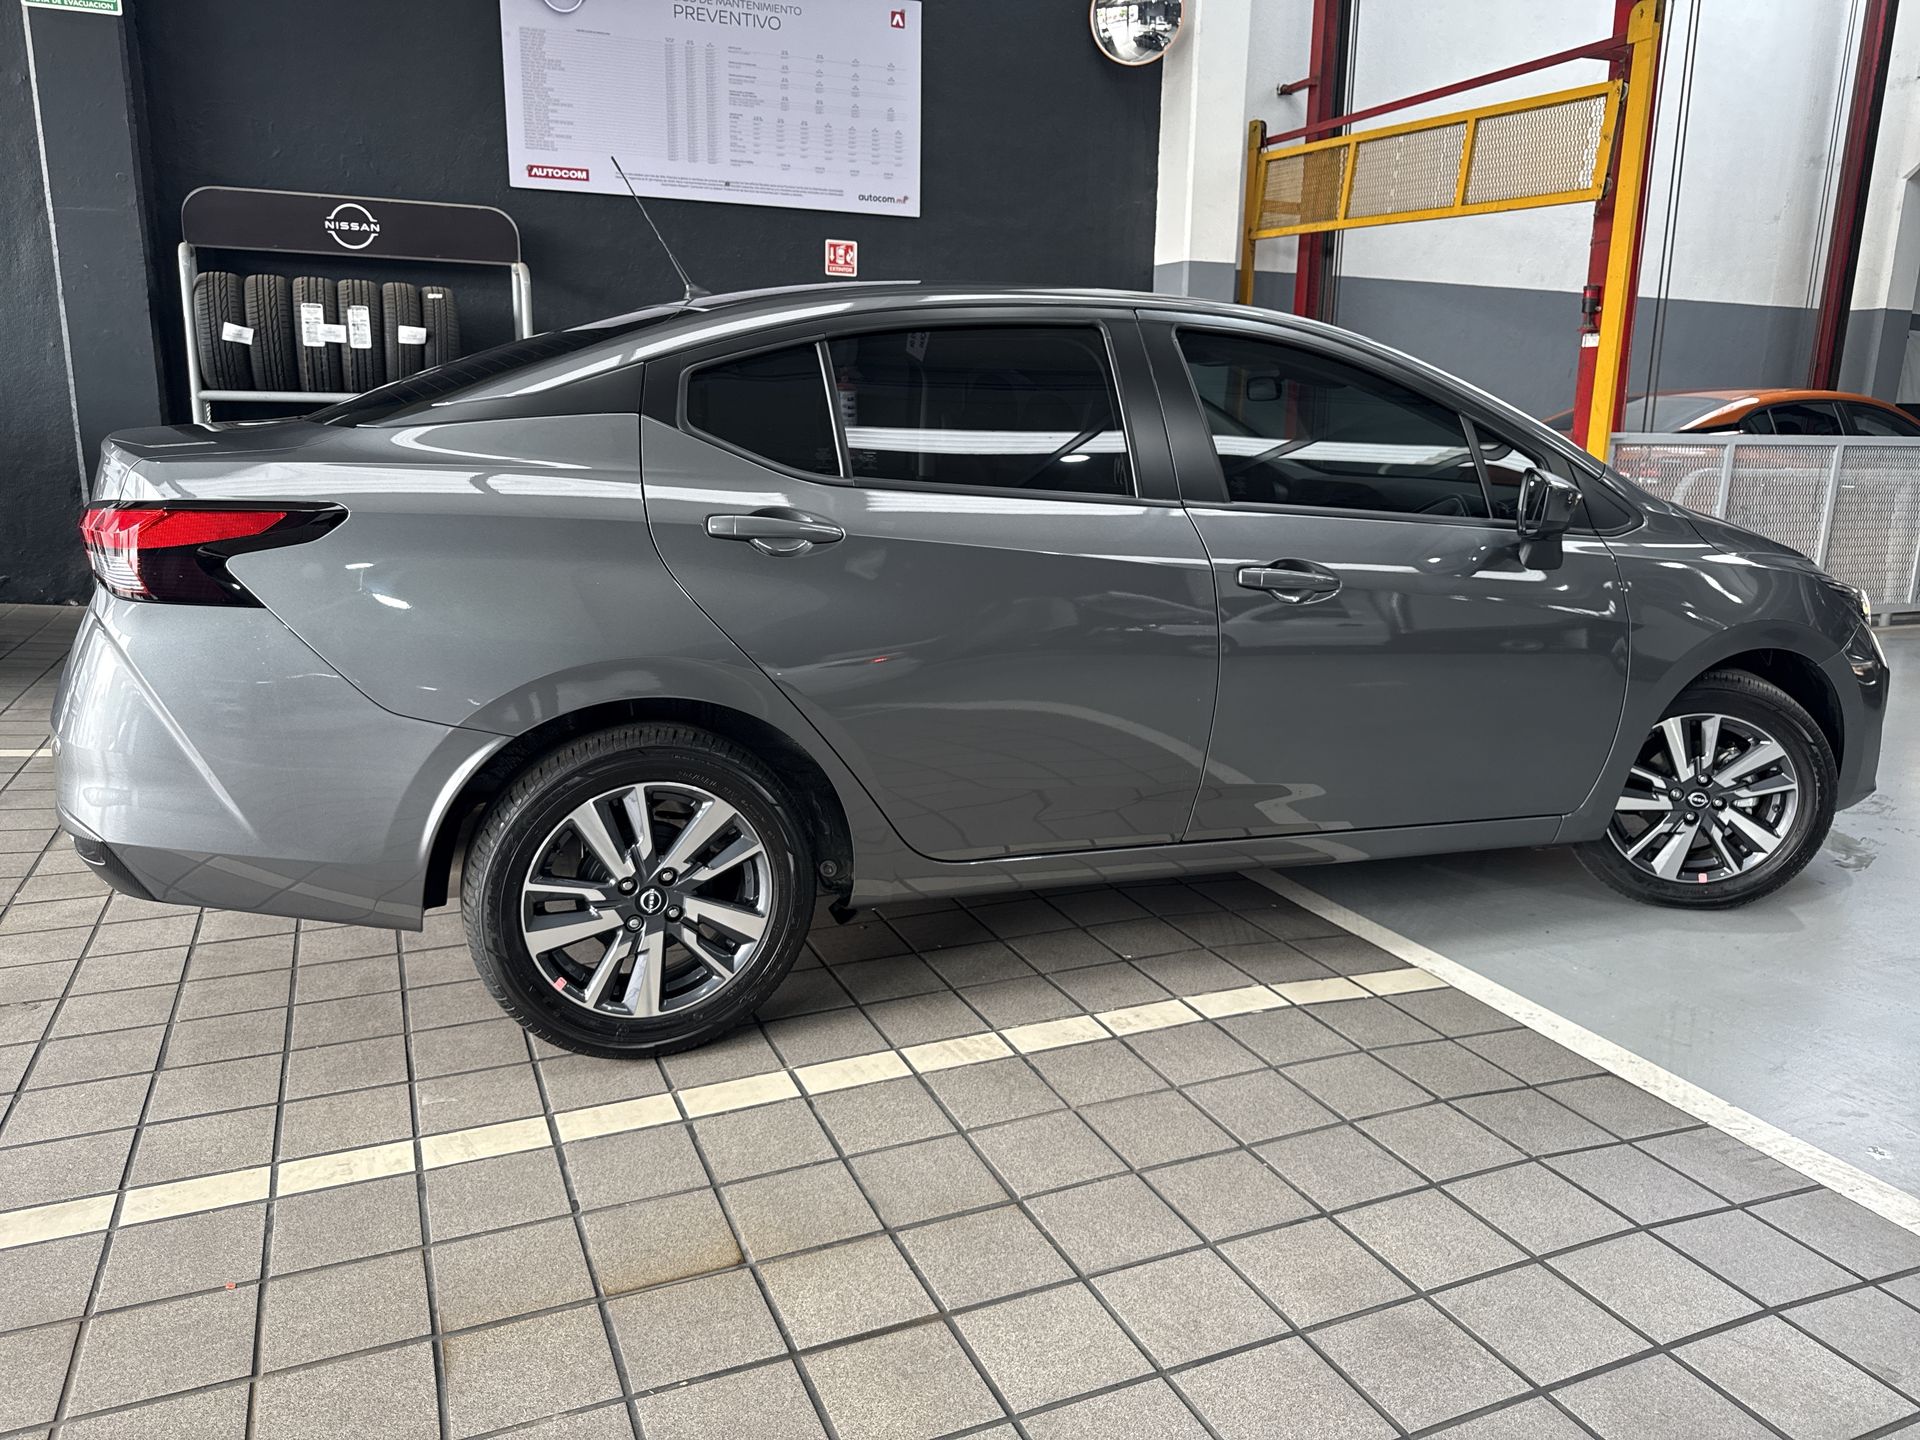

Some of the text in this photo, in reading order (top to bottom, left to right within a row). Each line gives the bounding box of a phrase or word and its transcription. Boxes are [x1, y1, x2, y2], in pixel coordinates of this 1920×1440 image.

[715, 0, 802, 16] MANTENIMIENTO
[673, 4, 781, 30] PREVENTIVO
[531, 167, 587, 180] AUTOCOM
[324, 220, 380, 232] NISSAN
